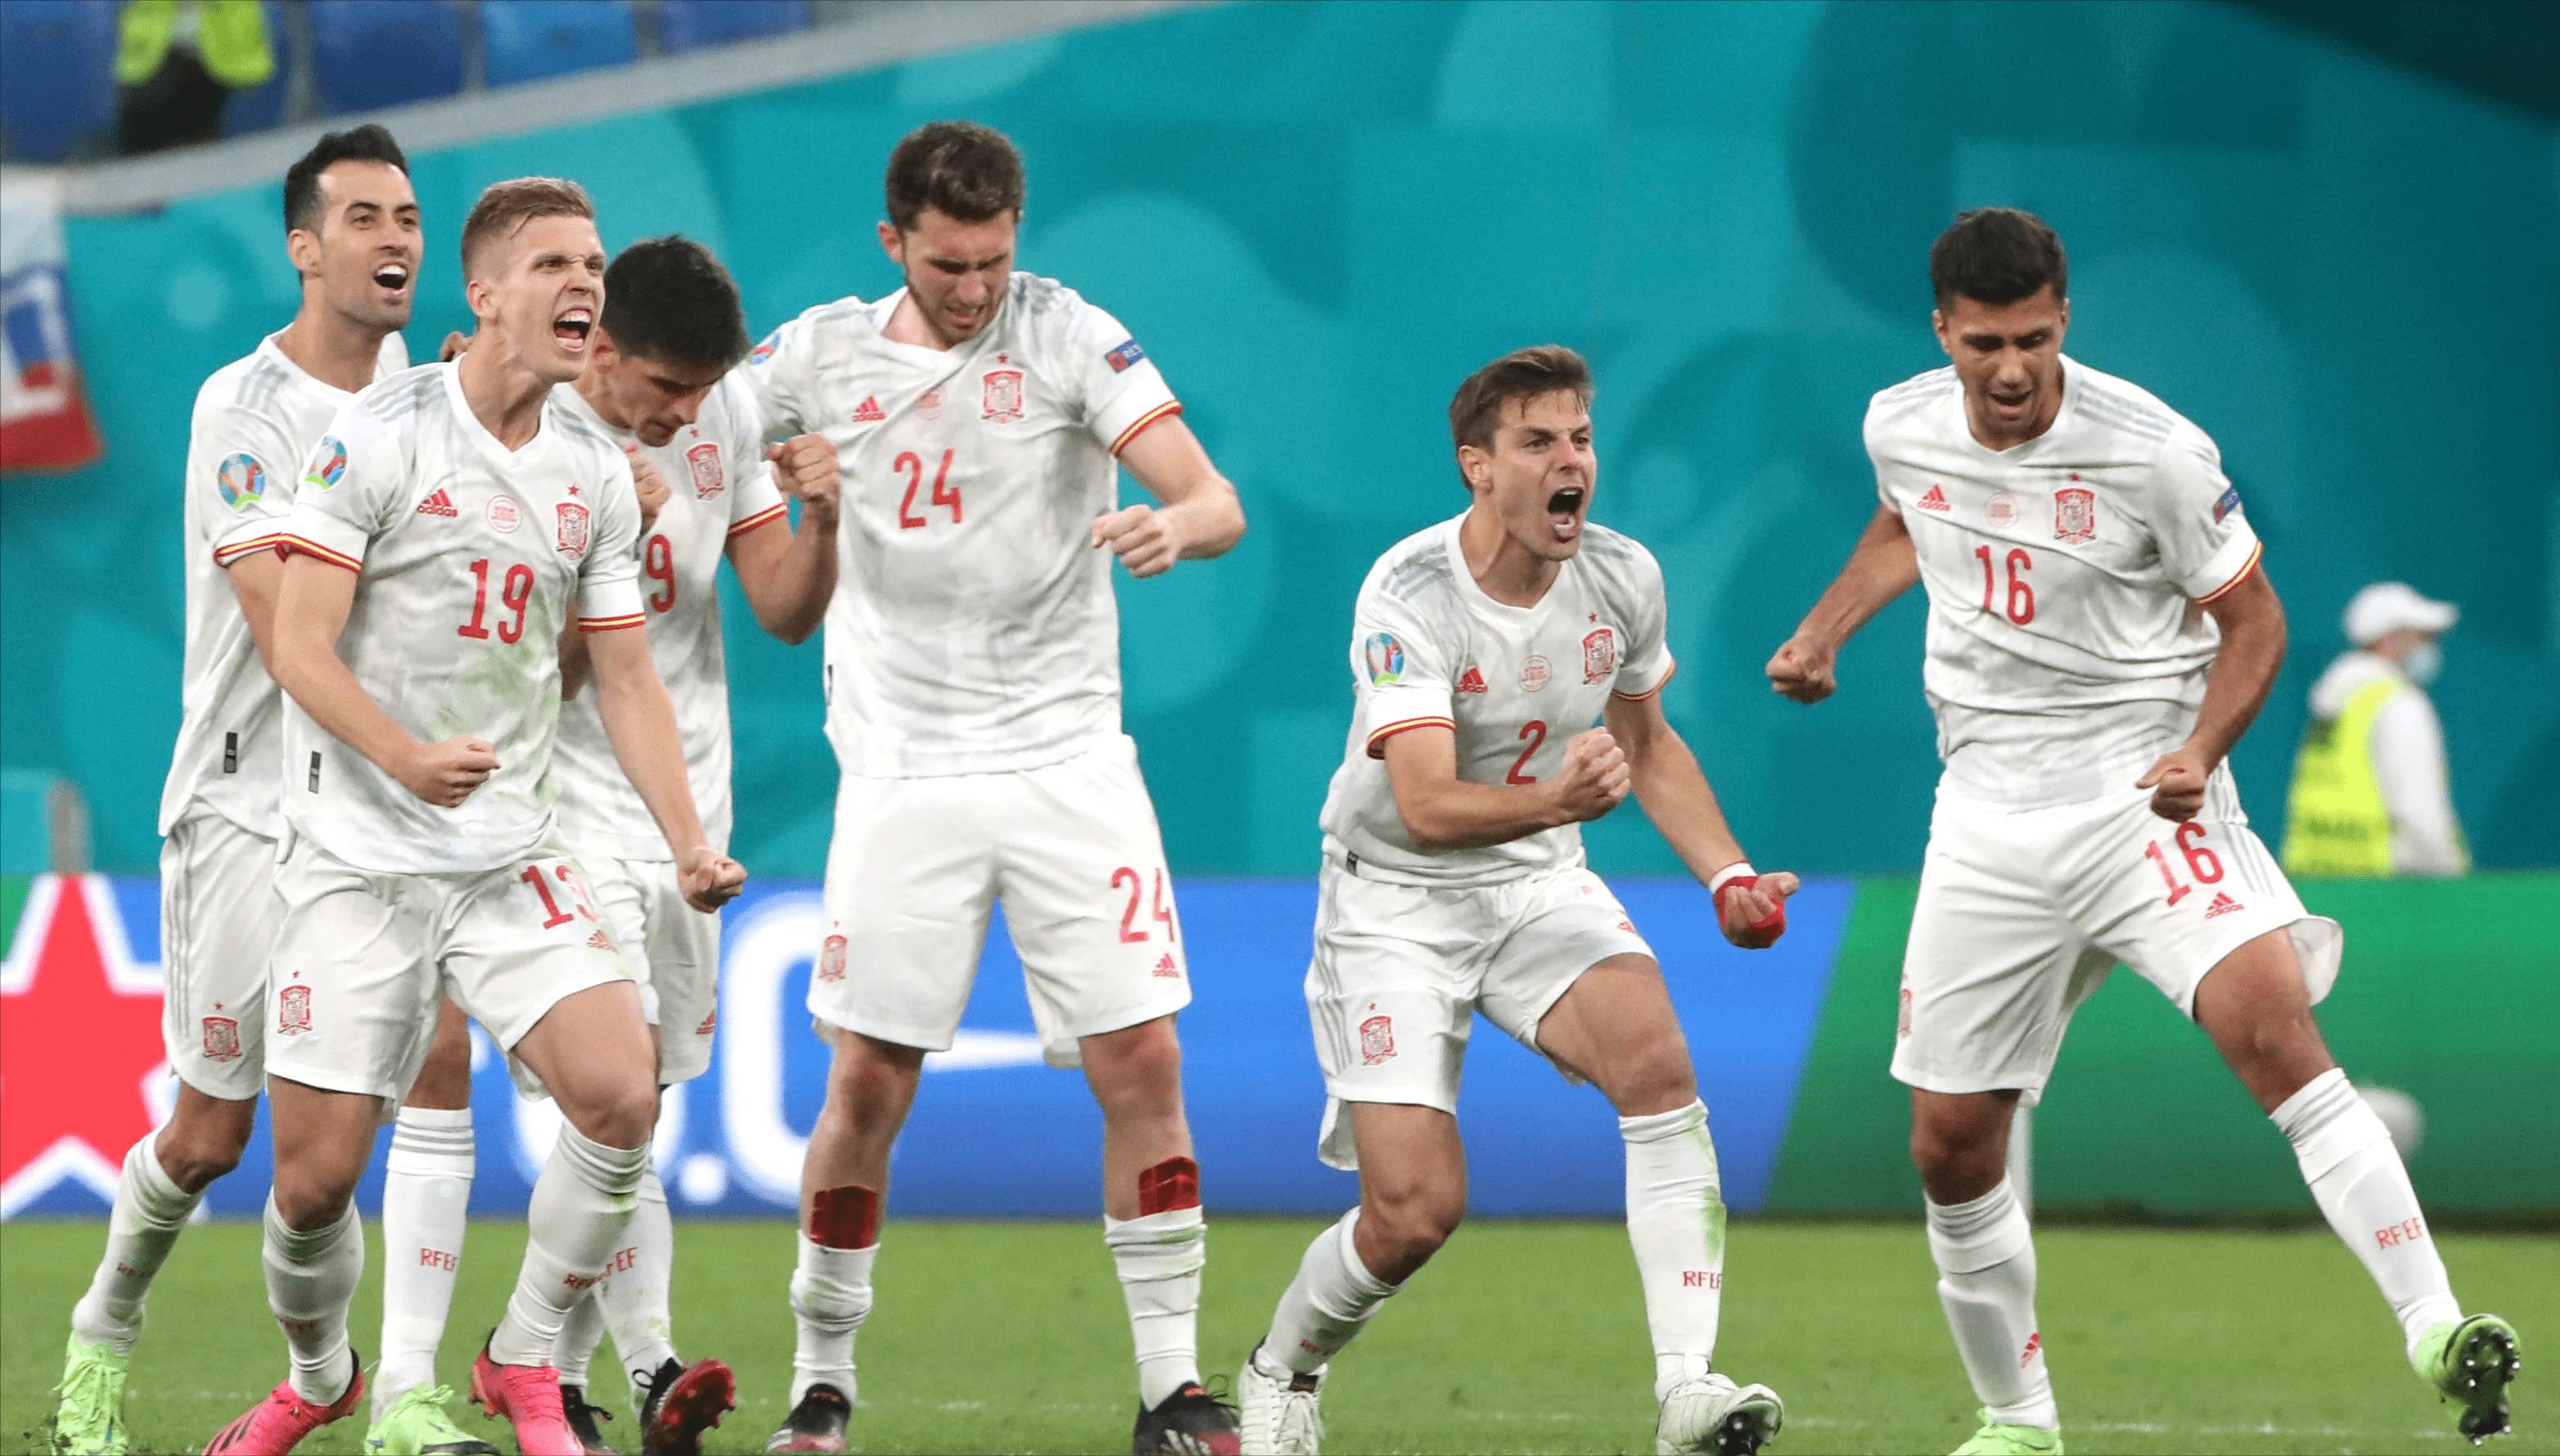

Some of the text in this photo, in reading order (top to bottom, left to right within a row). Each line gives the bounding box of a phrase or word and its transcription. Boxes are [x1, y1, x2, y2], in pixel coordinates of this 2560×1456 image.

[417, 503, 458, 517] adidas
[894, 449, 962, 529] 24
[457, 558, 534, 644] 19
[646, 534, 674, 613] 9
[1975, 545, 2035, 625] 16
[1506, 719, 1547, 785] 2
[2145, 821, 2224, 907] 16
[1111, 867, 1175, 944] 24
[420, 1248, 458, 1271] RFEF
[2375, 1217, 2423, 1249] RFEF
[1683, 1270, 1723, 1289] RFEF
